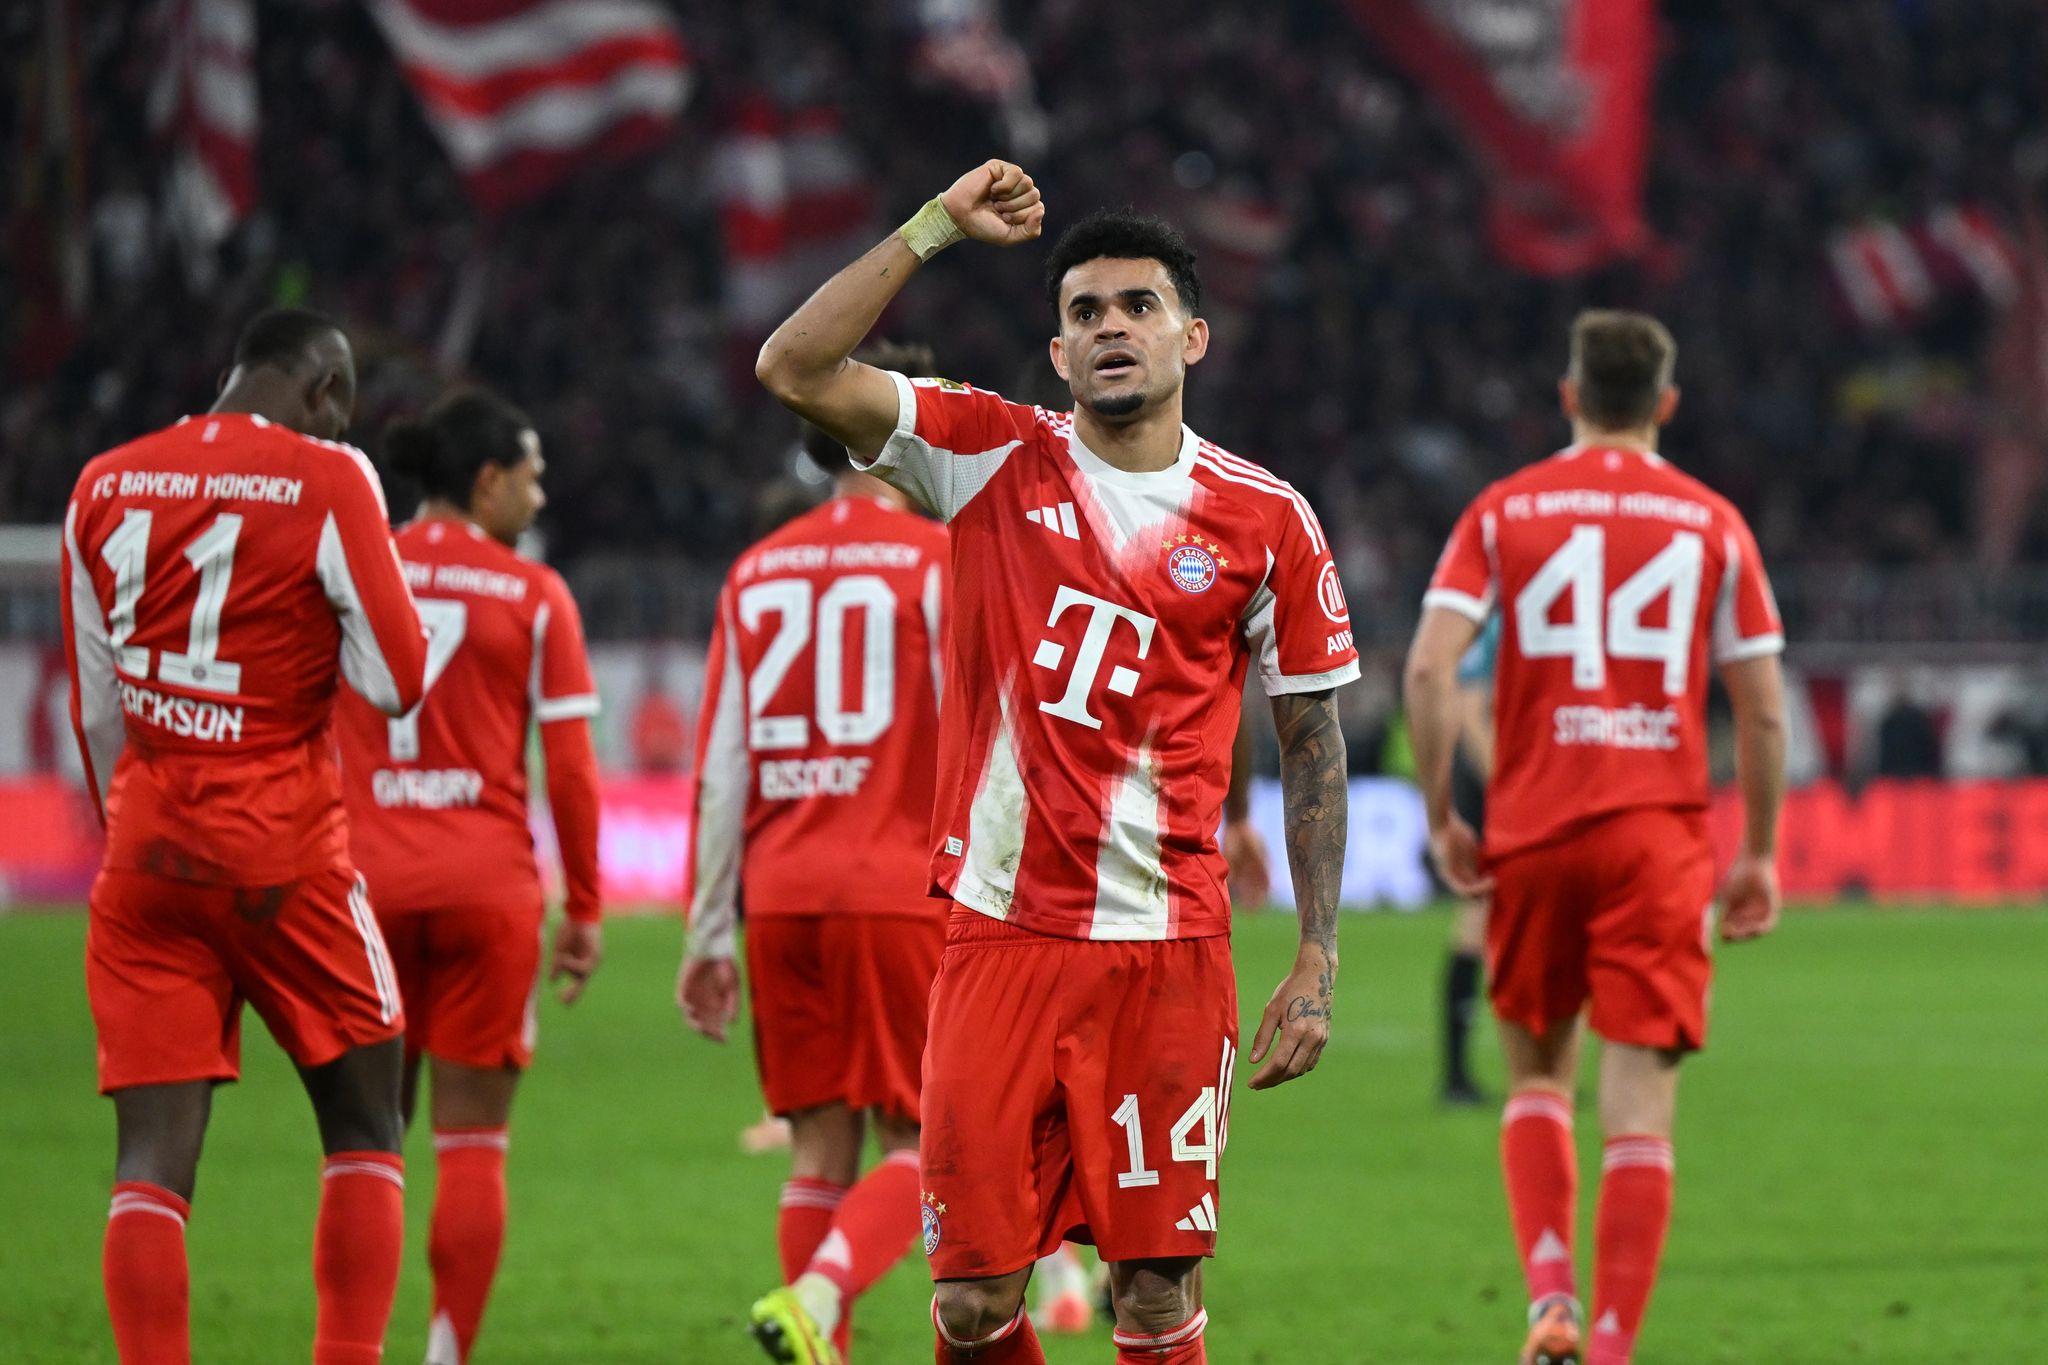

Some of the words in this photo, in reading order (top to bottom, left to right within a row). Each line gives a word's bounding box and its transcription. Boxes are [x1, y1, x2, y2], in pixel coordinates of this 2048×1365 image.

[92, 473, 116, 502] FC
[118, 471, 198, 499] BAYERN
[101, 508, 243, 695] 11
[1172, 568, 1210, 590] MÜNCHEN
[1173, 551, 1184, 562] FC
[1184, 549, 1213, 572] BAYERN
[1514, 523, 1704, 697] 44
[739, 573, 897, 751] 20
[119, 680, 244, 743] ACKSON
[1111, 1087, 1217, 1189] 14
